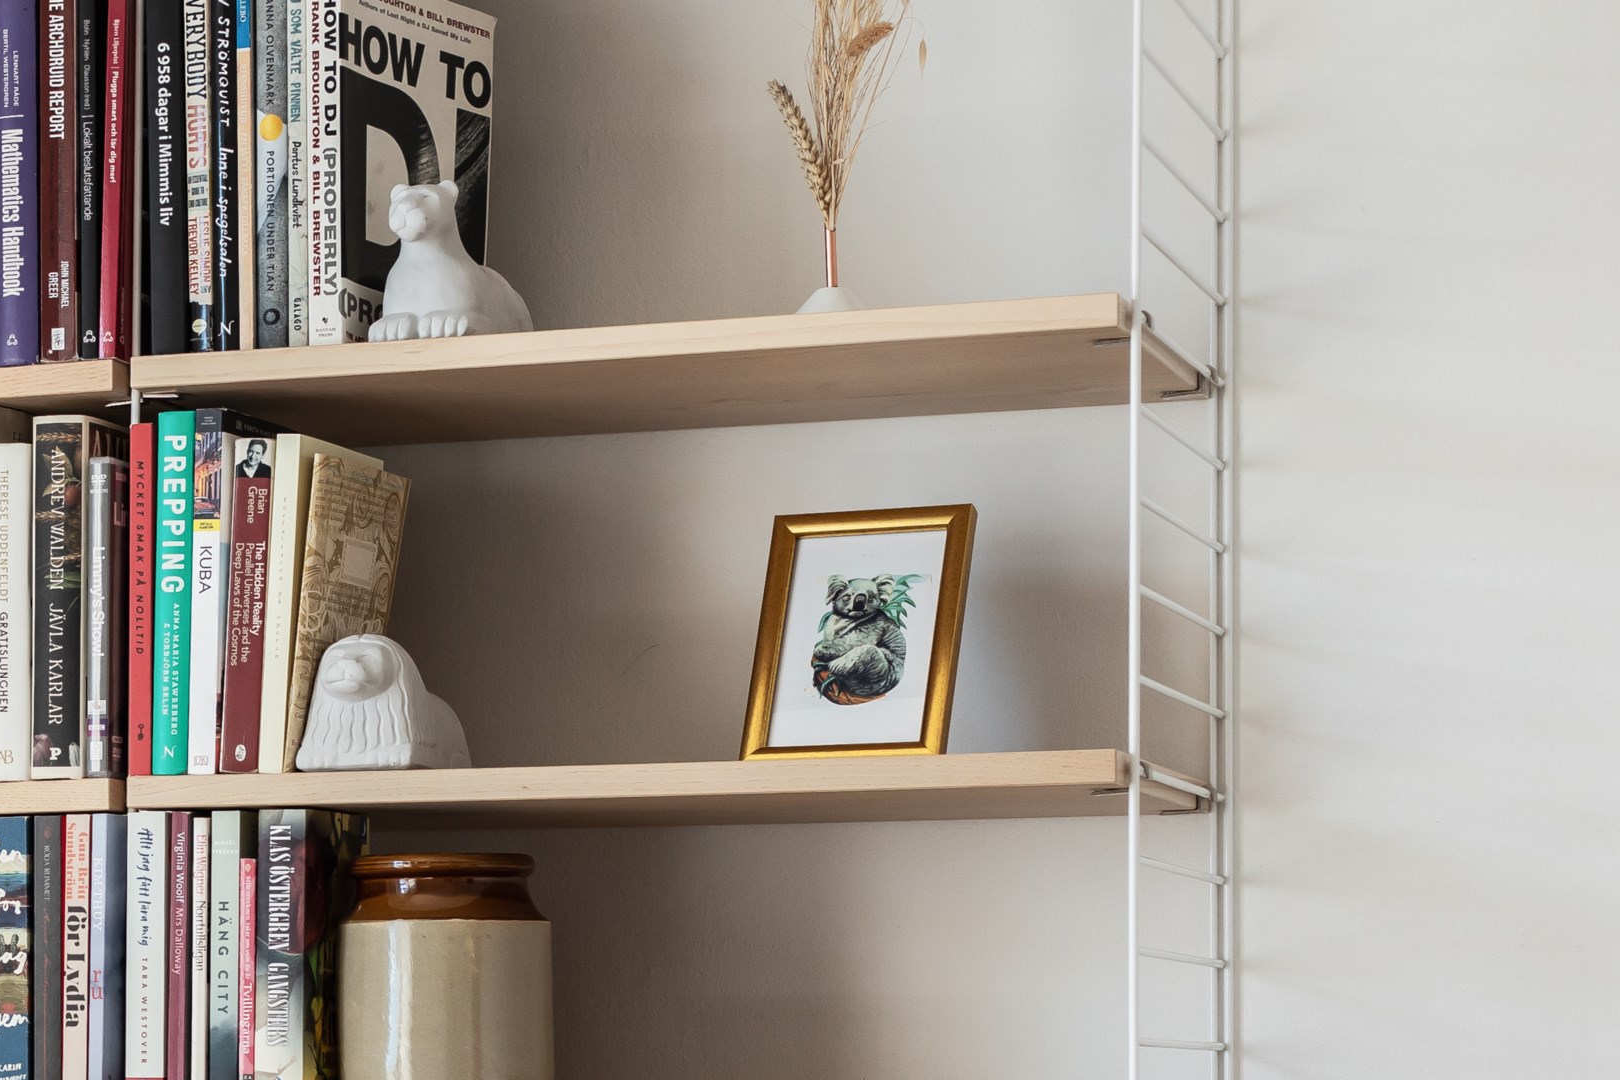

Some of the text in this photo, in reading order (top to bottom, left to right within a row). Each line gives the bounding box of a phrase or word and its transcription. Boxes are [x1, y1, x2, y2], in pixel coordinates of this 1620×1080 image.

[49, 15, 63, 87] ARCHDRUID
[158, 43, 170, 52] 6
[158, 56, 170, 84] 958
[266, 36, 274, 105] OLVENMARK
[324, 61, 336, 92] TO
[340, 13, 491, 108] HOW TO
[49, 91, 64, 139] REPORT
[156, 88, 170, 132] dagar
[188, 105, 206, 169] HURTS
[324, 105, 336, 136] DJ
[159, 144, 171, 203] Mimmis
[312, 50, 321, 296] BROUGHTON & BILL BREWSTER
[2, 129, 24, 297] Mathematics Handbook
[160, 206, 171, 225] liv
[266, 151, 274, 292] PORTIONEN UNDER TIAN
[323, 148, 338, 296] (PROPERLY)
[293, 298, 301, 331] GALAGO
[0, 470, 9, 602] THERESE UDDENFELDT
[49, 449, 66, 589] ANDREV WALDEN
[136, 524, 144, 563] SMAK
[162, 435, 186, 592] PREPPING
[136, 570, 147, 586] PÅ
[199, 546, 212, 593] KUBA
[250, 541, 265, 635] The Hidden Reality
[0, 612, 8, 713] GRATISLUNCHEN
[49, 603, 66, 724] JÄVLA KARLAR
[135, 595, 144, 655] NOLLTID
[172, 832, 185, 974] Virginia Woolf Mrs Dalloway
[268, 825, 294, 950] KLAS ÖSTERGREN
[65, 906, 86, 1027] för Lydia
[217, 902, 232, 1014] HÄNG CITY
[268, 962, 288, 1046] GANGSTERS
